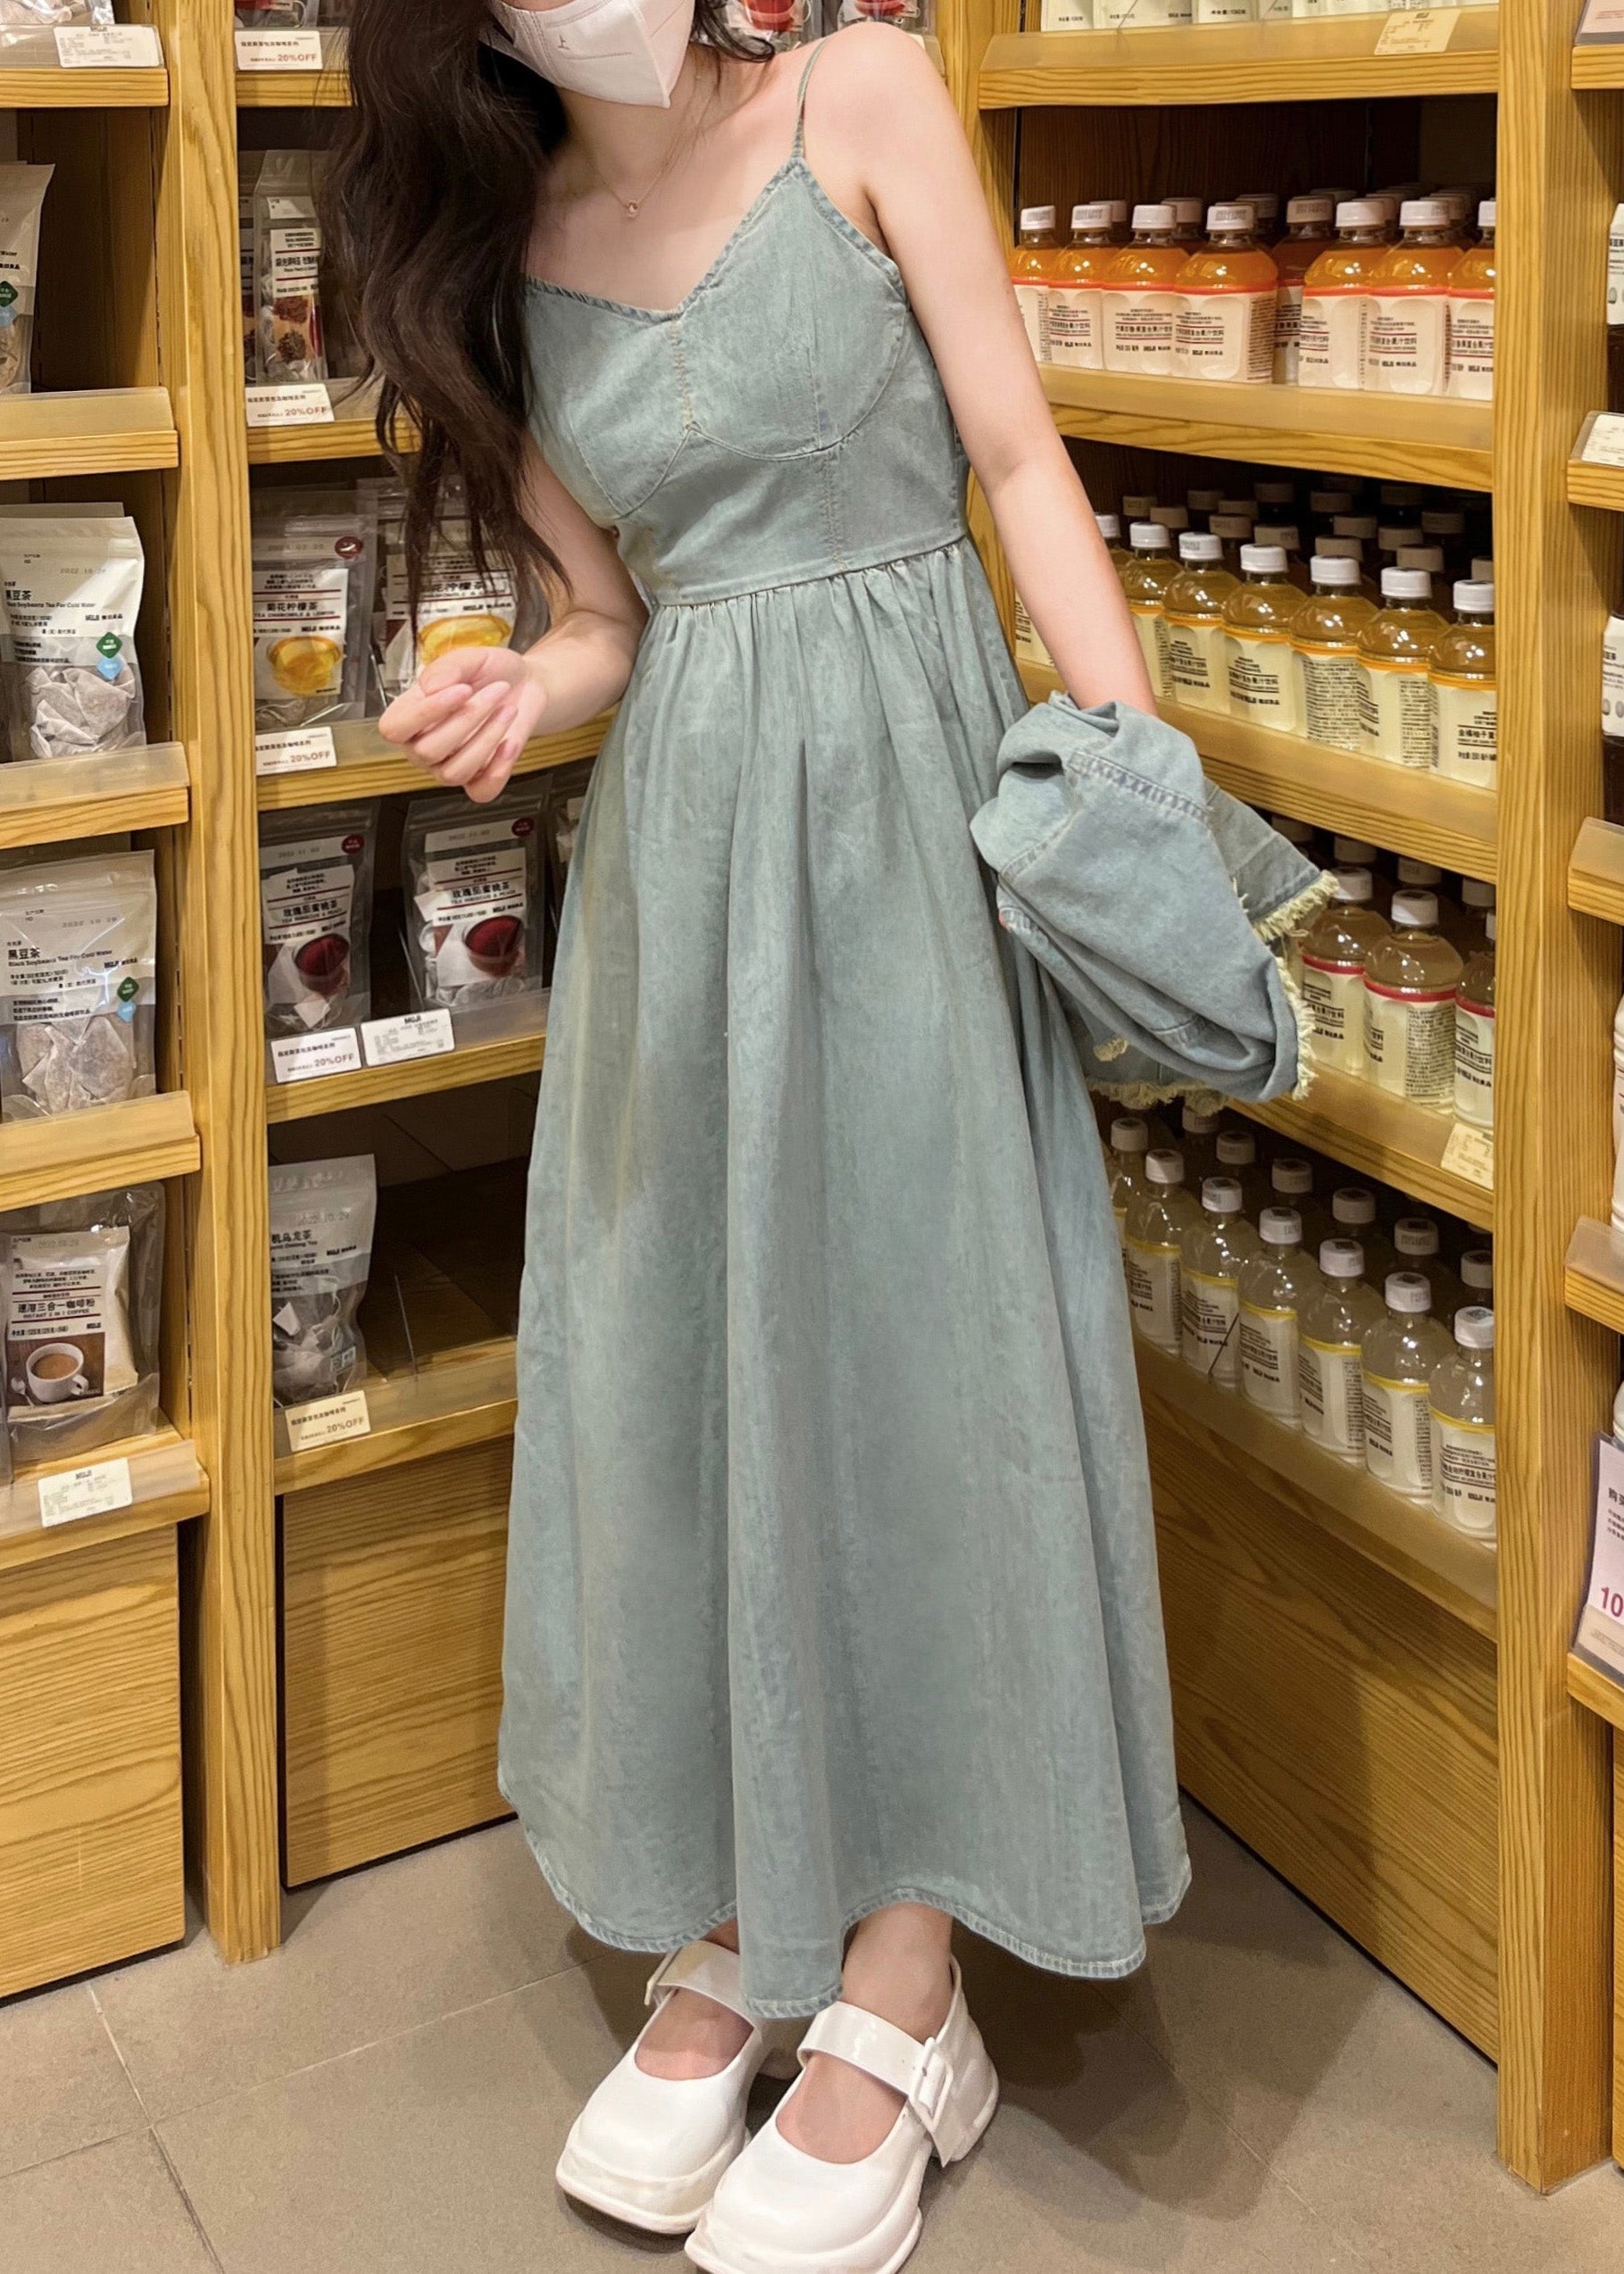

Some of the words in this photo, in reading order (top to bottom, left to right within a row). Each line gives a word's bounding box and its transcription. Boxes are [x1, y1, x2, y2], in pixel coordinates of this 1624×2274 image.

[278, 54, 317, 62] 20%OFF
[285, 406, 327, 416] 20%OFF
[290, 751, 330, 762] 20%OFF
[8, 947, 41, 961] 黑豆茶
[404, 1016, 421, 1024] MUJI
[314, 1054, 354, 1068] 20%OFF
[327, 1417, 364, 1434] 20%OFF
[1602, 1587, 1623, 1618] 10
